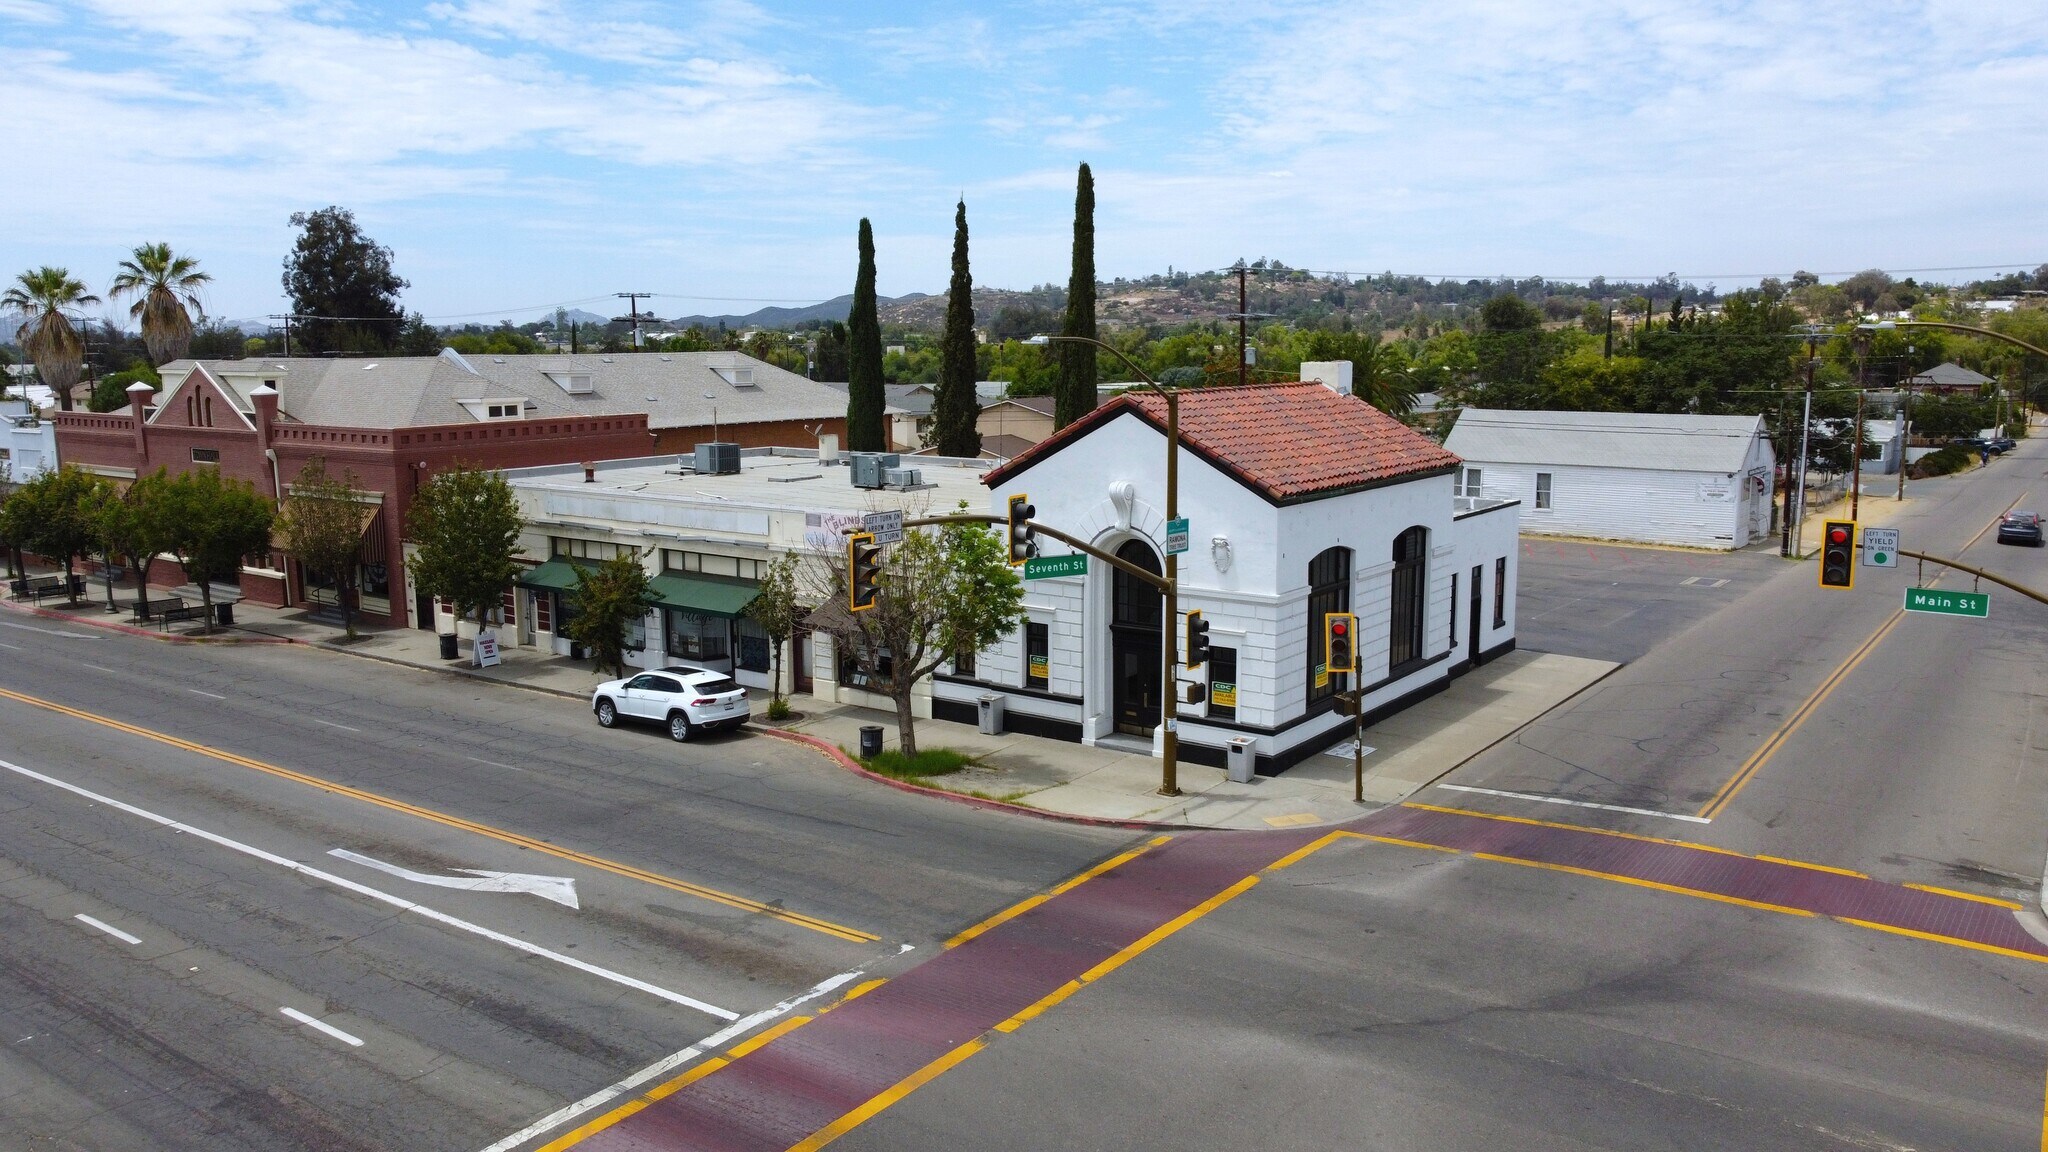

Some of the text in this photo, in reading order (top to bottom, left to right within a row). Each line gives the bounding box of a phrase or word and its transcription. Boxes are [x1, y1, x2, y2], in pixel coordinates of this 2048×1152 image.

[824, 514, 835, 523] THE
[833, 516, 865, 530] BLINDS
[866, 515, 878, 524] LEFT
[879, 514, 892, 522] TURN
[885, 532, 899, 540] TURN
[1169, 534, 1186, 543] RAMONA
[1029, 560, 1083, 574] Seventh St
[1915, 595, 1976, 609] Main St
